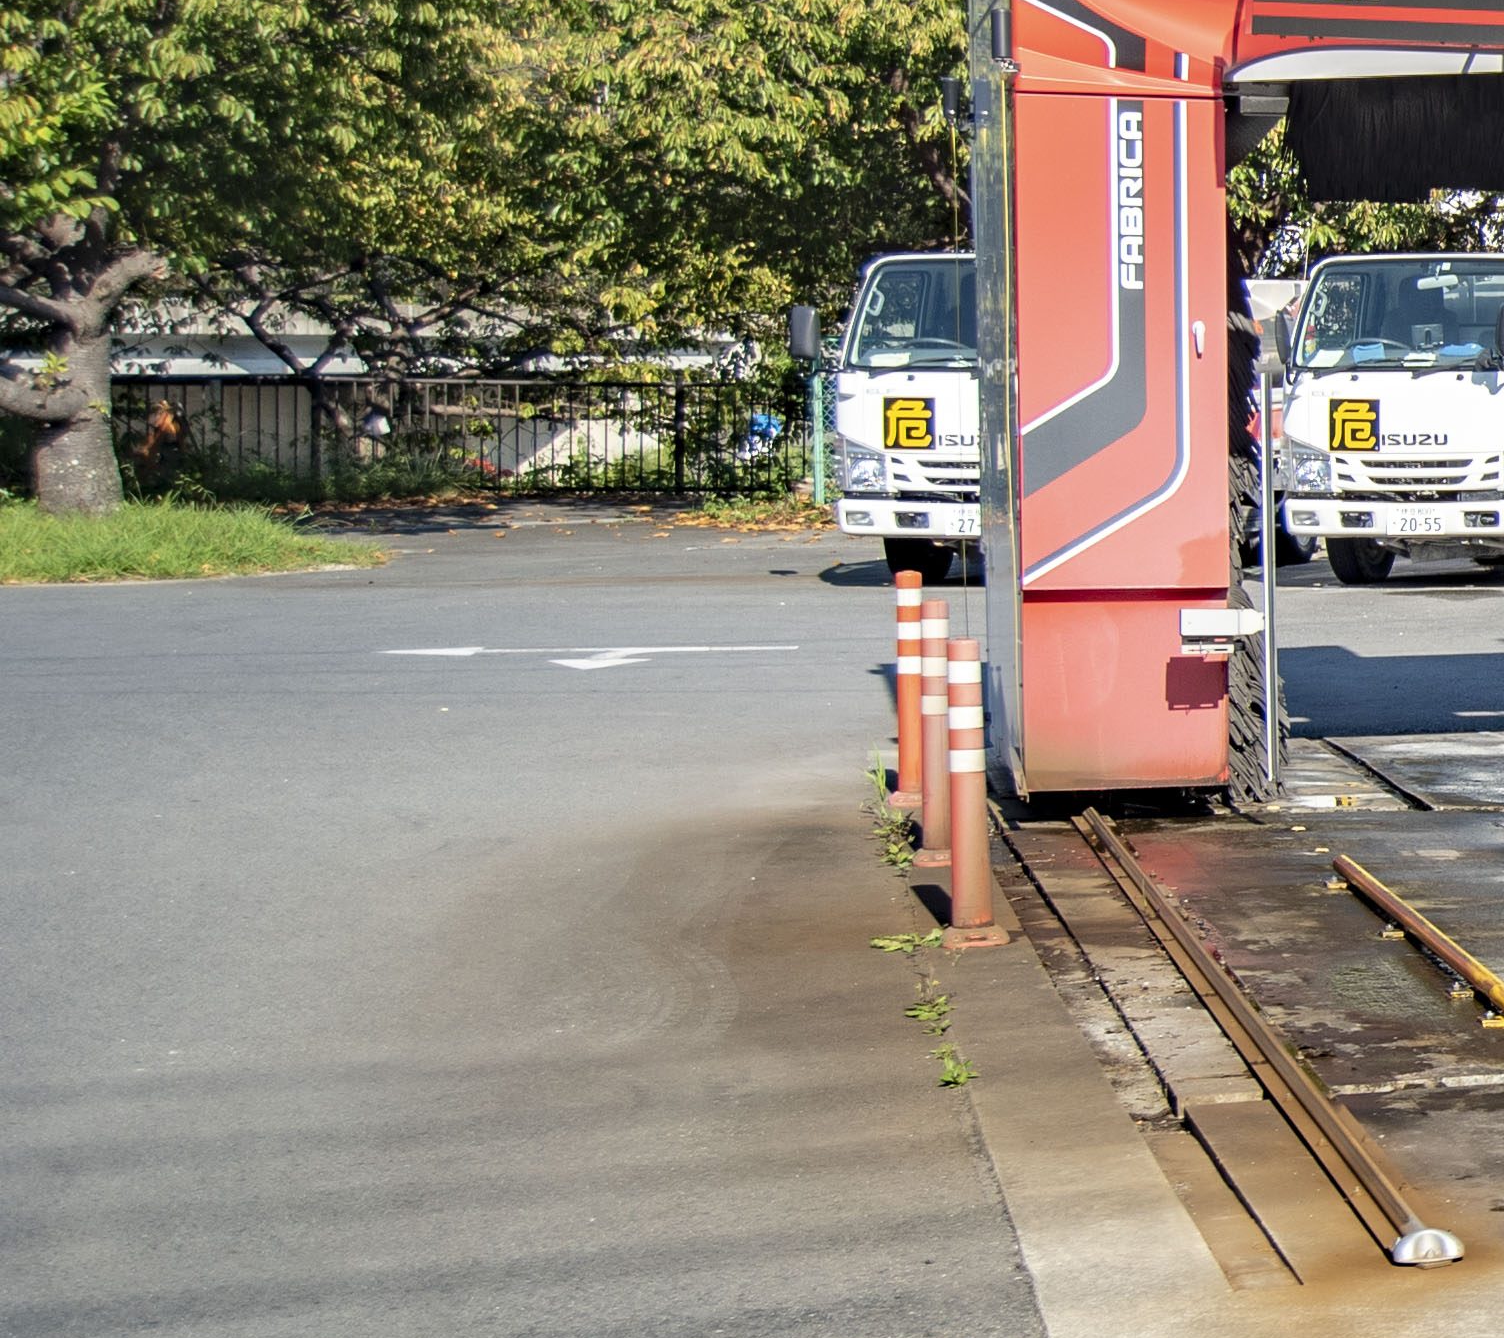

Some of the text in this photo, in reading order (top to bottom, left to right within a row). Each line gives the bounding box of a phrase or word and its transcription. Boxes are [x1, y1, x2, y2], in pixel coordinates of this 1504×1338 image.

[1118, 110, 1143, 290] FABRICA
[886, 399, 932, 447] 危
[1331, 402, 1377, 448] 危
[938, 434, 980, 446] ISU
[1381, 433, 1448, 446] ISUZU
[1400, 517, 1442, 531] 20-55
